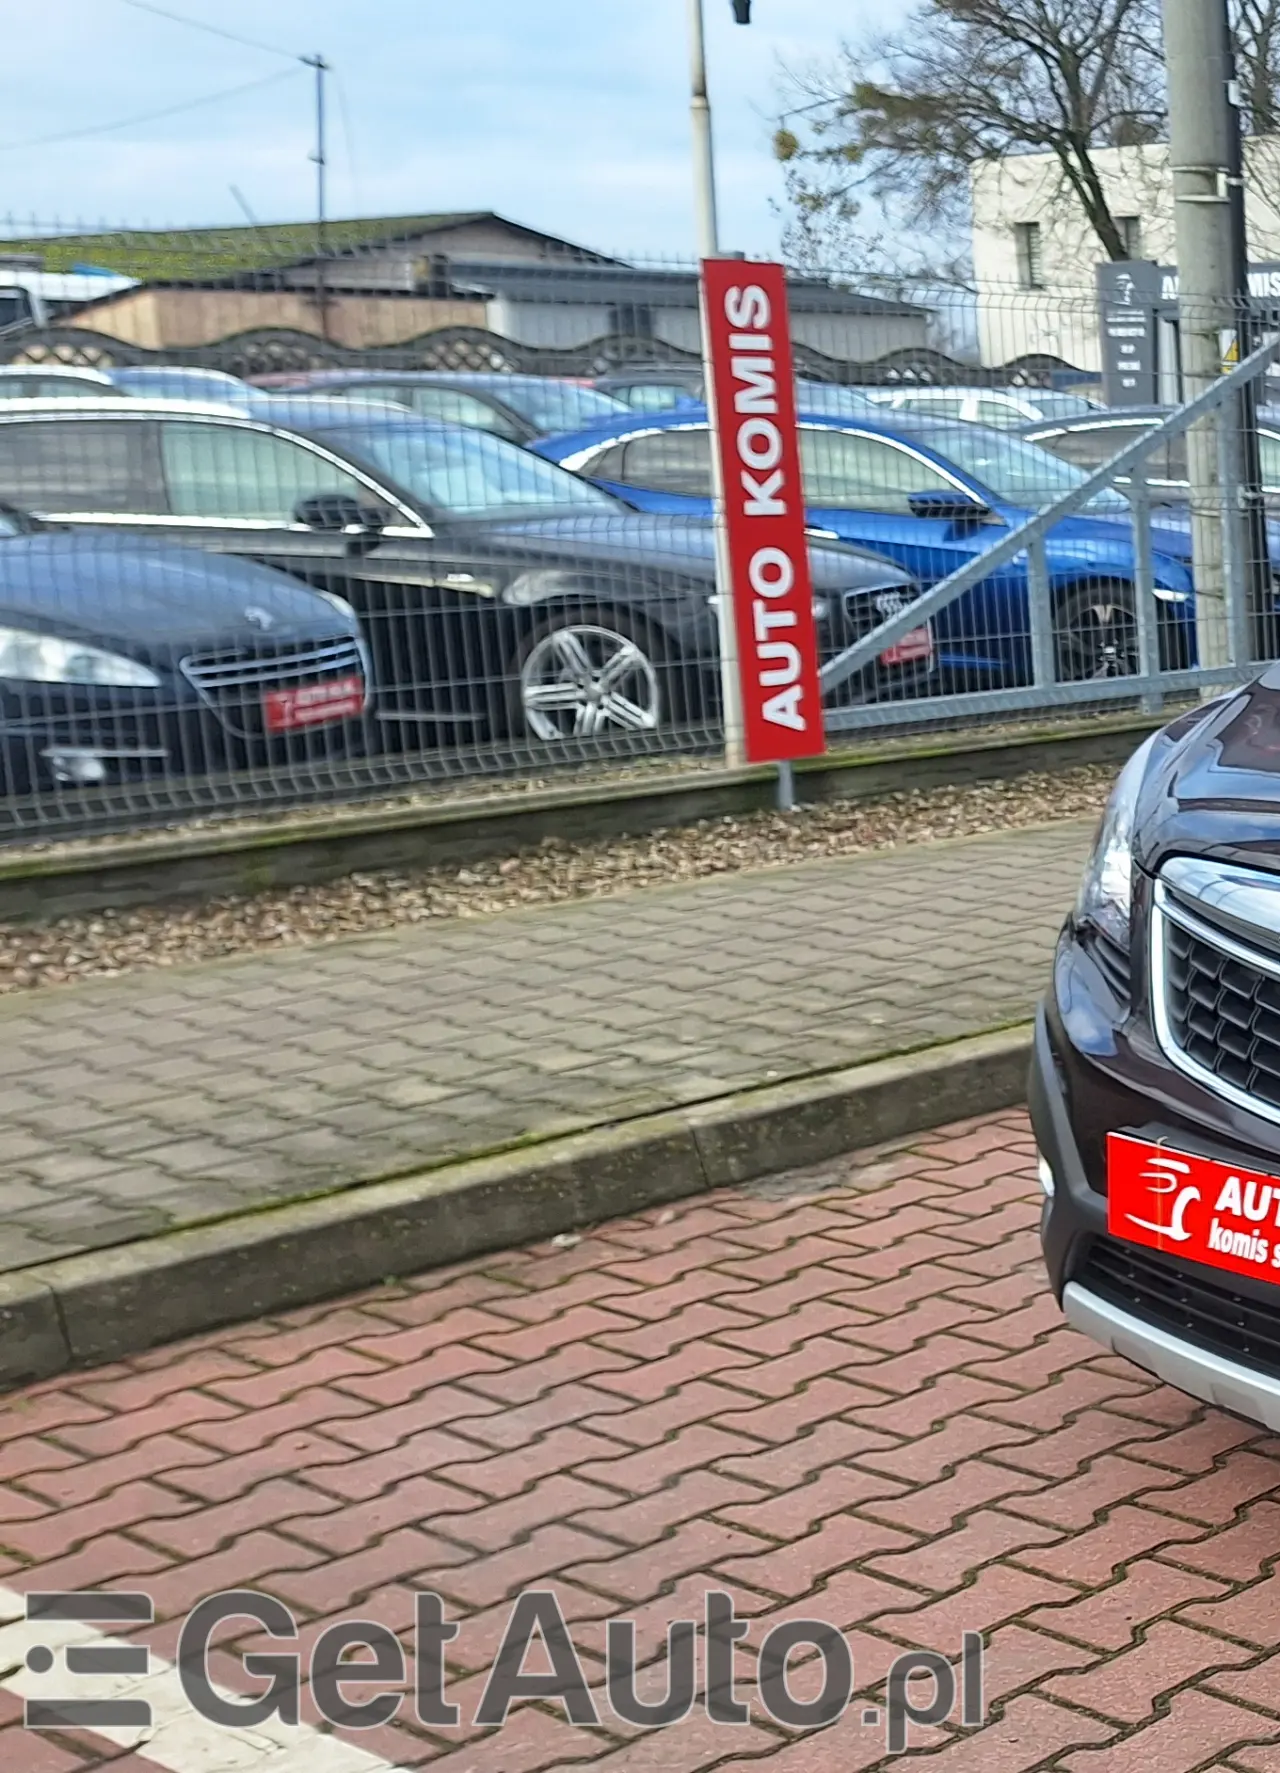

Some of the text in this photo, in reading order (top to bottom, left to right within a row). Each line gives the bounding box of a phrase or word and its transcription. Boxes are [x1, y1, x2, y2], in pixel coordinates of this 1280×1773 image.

[725, 284, 807, 731] AUTO KOMIS
[1207, 1217, 1269, 1264] komis
